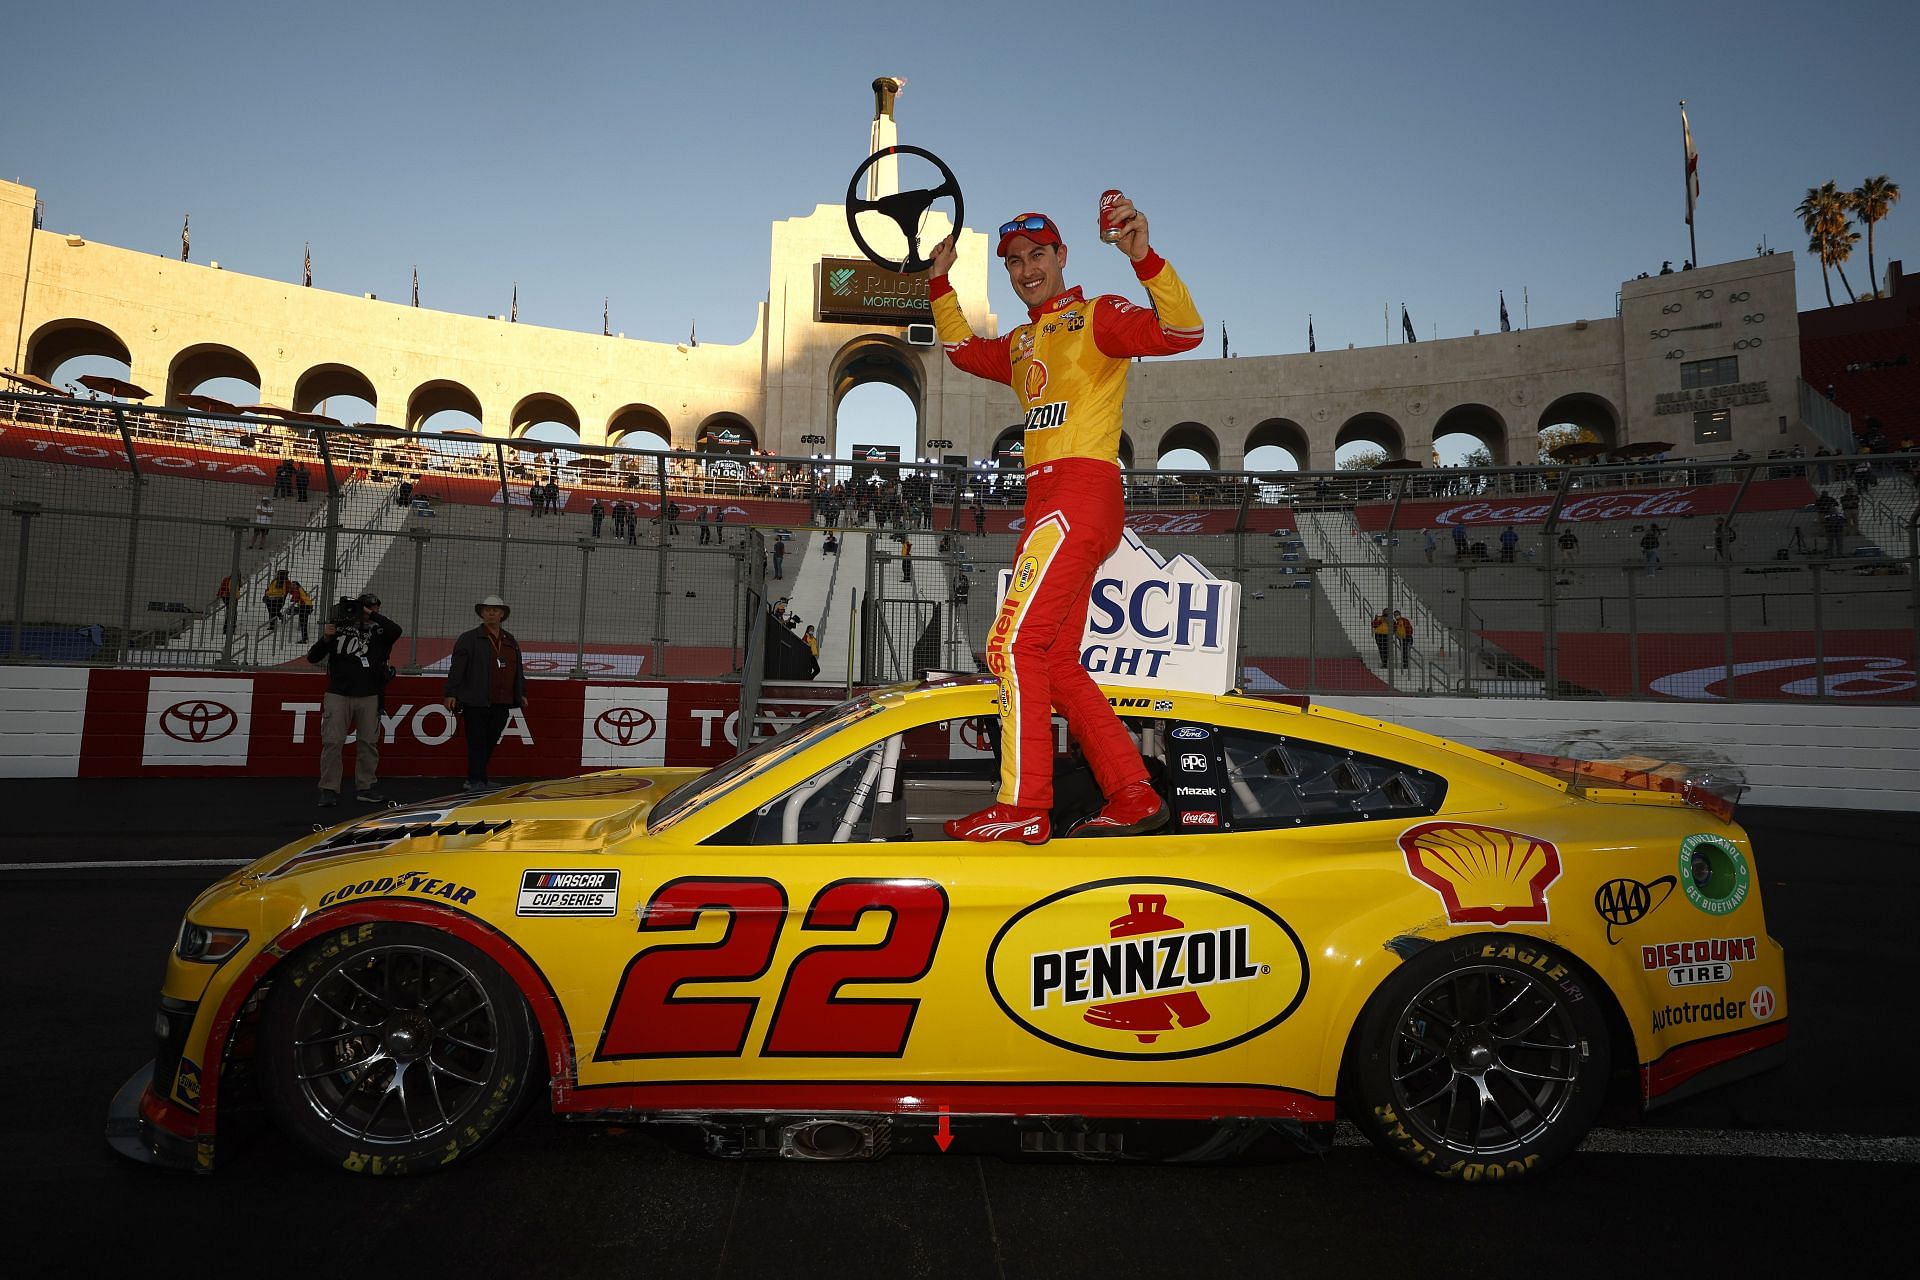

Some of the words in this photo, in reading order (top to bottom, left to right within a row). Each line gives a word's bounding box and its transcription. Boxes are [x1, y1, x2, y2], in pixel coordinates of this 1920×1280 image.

[863, 296, 929, 309] MORTGAGE
[1696, 289, 1714, 301] 70
[1729, 291, 1751, 303] 80
[1662, 303, 1682, 315] 60
[1068, 316, 1084, 331] PPG
[1743, 313, 1765, 325] 90
[1650, 328, 1670, 340] 50
[1733, 337, 1762, 351] 100
[1665, 349, 1685, 360] 40
[1710, 380, 1768, 398] GEORGE
[1722, 392, 1771, 409] PLAZA
[25, 438, 267, 477] TOYOTA
[1435, 488, 1698, 525] CocaCola
[1003, 574, 1222, 648] SCH
[987, 598, 1020, 674] Shell
[1081, 645, 1170, 679] GHT
[1108, 697, 1151, 708] ANO
[281, 702, 534, 746] TYOA
[1178, 728, 1202, 738] Ford
[1182, 756, 1205, 770] PPG
[1176, 786, 1217, 796] Mazak
[1023, 824, 1040, 836] 22
[1680, 844, 1694, 862] GET
[554, 874, 606, 888] NASCAR
[533, 893, 558, 906] CUP
[558, 893, 603, 906] SERIES
[1600, 880, 1647, 923] AAA
[1687, 885, 1700, 902] GET
[1702, 881, 1748, 912] BIOETHANOL
[1642, 936, 1756, 970] DISCOUNT
[592, 875, 950, 1062] 22
[1480, 943, 1569, 982] EAGLE
[1674, 966, 1725, 983] TIRE
[1652, 997, 1747, 1034] Autotrader
